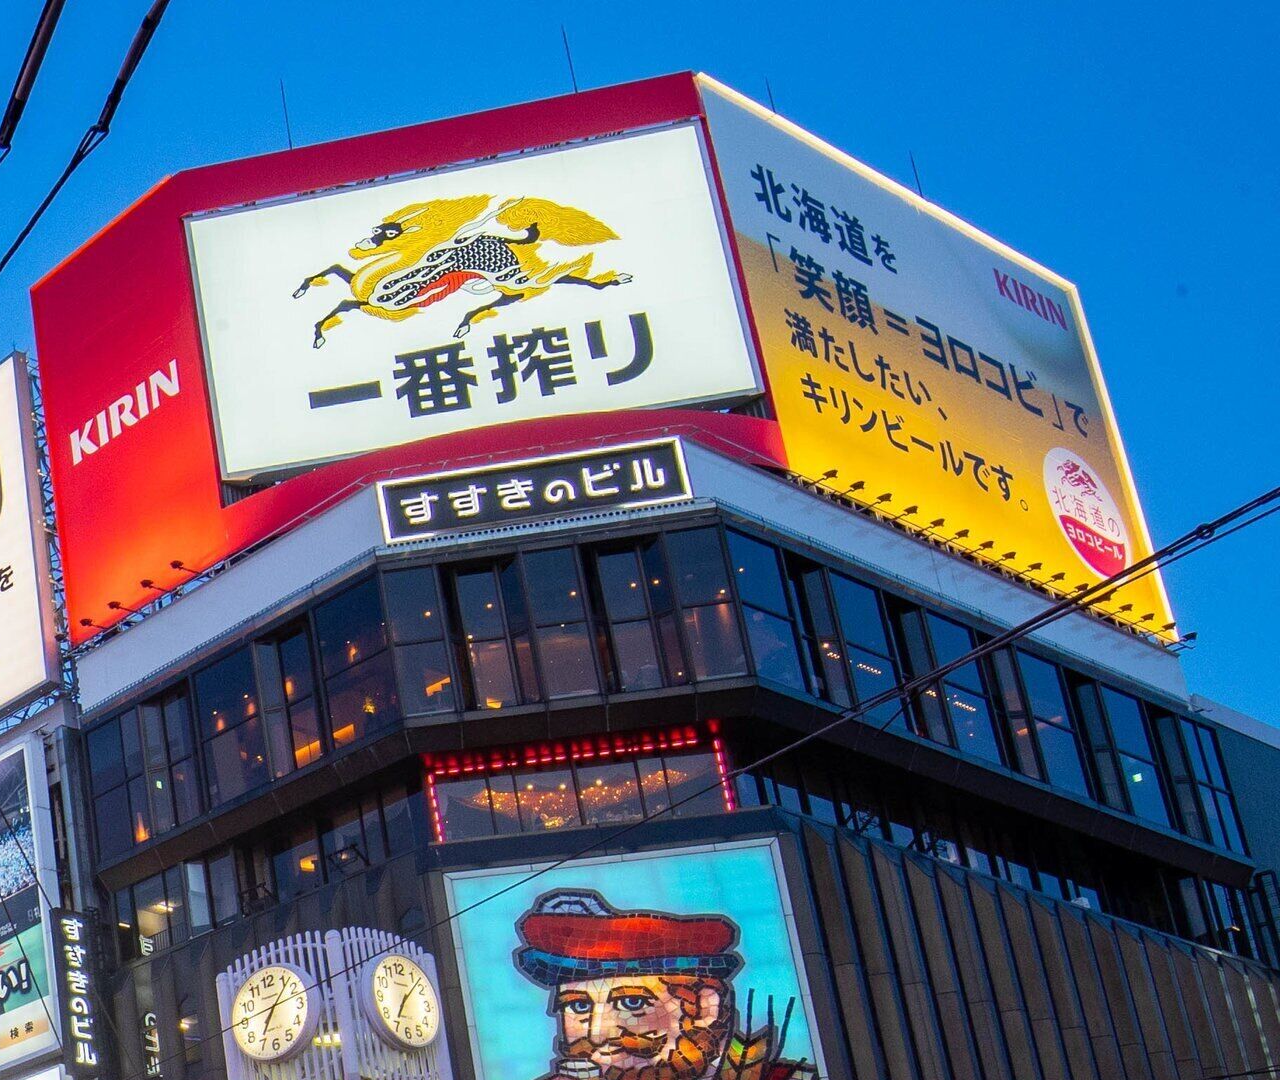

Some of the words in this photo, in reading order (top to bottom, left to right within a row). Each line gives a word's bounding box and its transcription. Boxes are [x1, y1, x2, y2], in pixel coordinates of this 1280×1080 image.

[750, 163, 898, 275] 北海道を
[993, 268, 1068, 332] KIRIN
[69, 358, 180, 467] KIRIN
[308, 311, 655, 419] 一番搾り
[785, 308, 948, 422] 満たしたい、
[400, 463, 667, 524] すすきのビル
[801, 373, 1029, 512] キリンビールです。
[1052, 486, 1121, 538] 北海道の
[1066, 523, 1124, 560] ヨロコビール
[60, 918, 97, 1066] すすきのビル
